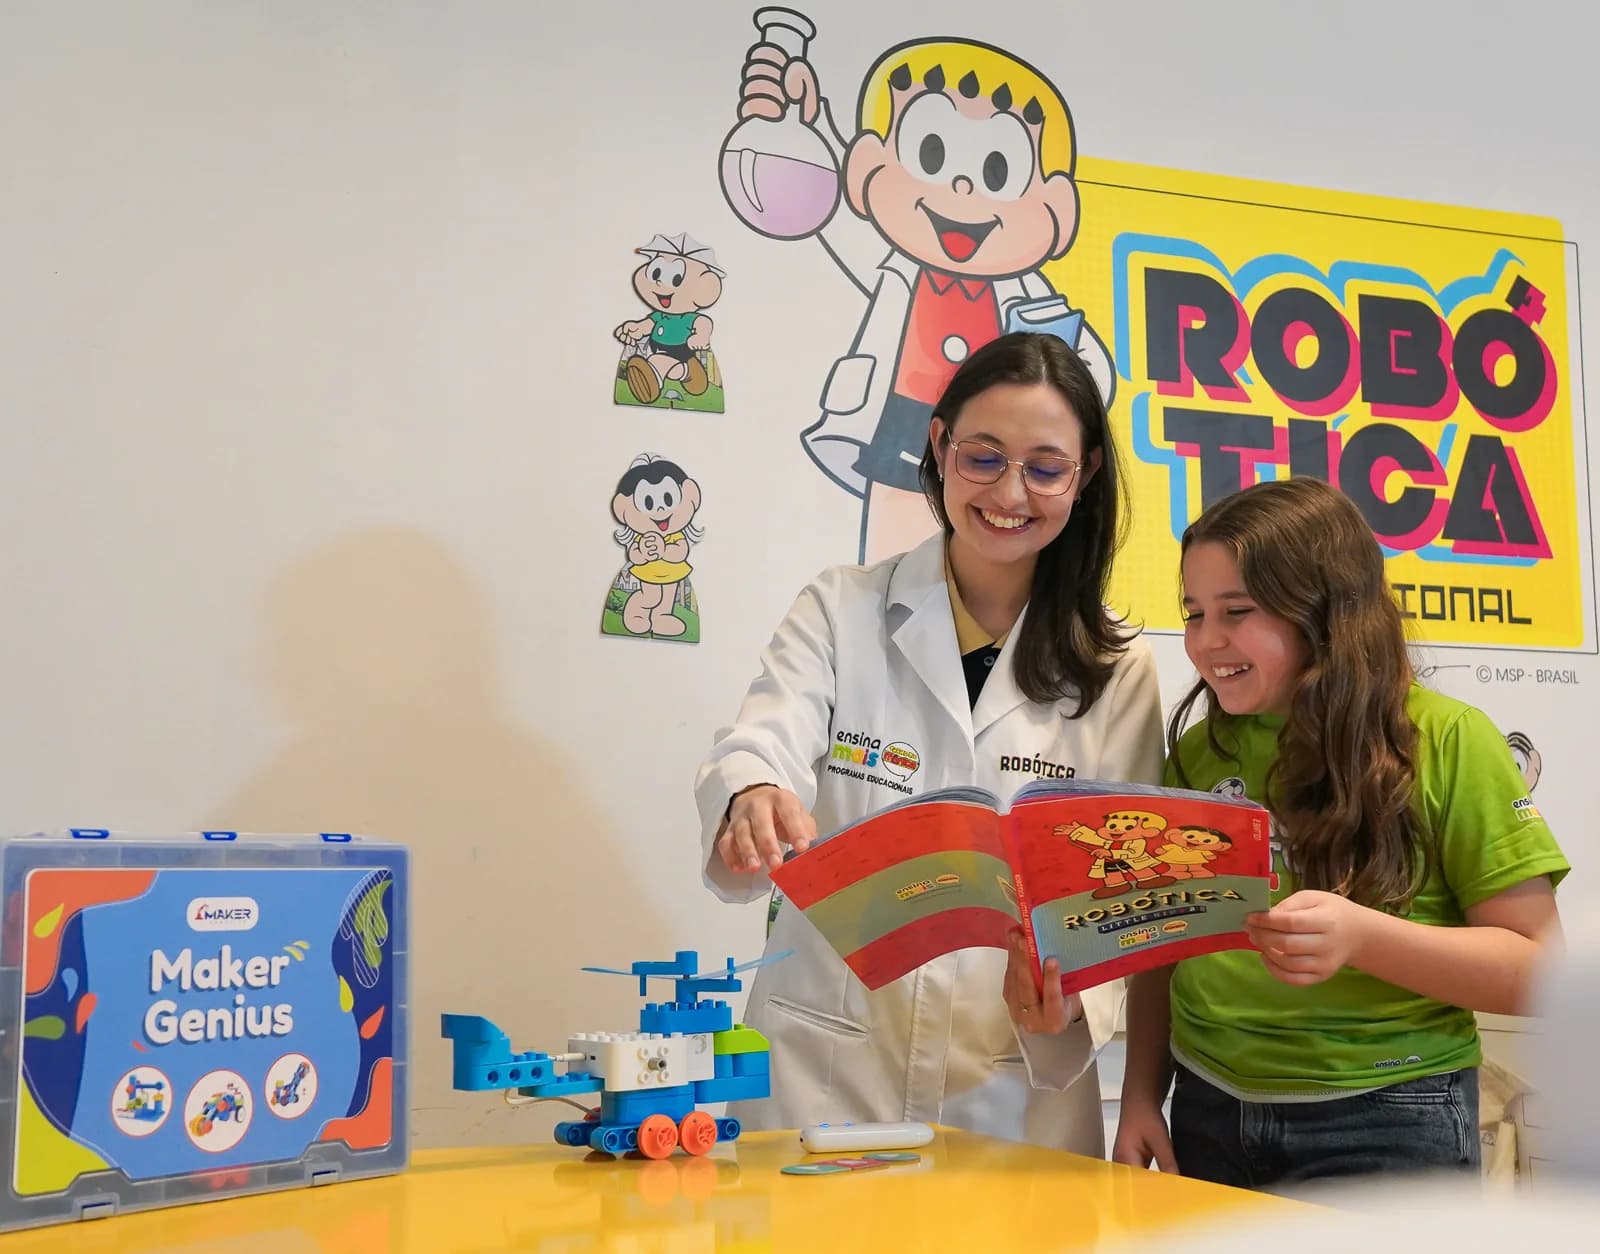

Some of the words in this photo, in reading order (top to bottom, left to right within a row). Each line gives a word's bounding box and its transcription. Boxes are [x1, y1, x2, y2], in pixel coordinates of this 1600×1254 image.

[1144, 267, 1557, 432] ROBÓ
[1163, 407, 1553, 558] TICA
[1391, 583, 1533, 625] IONAL
[1496, 668, 1525, 682] MSP
[1536, 669, 1580, 684] BRASIL
[836, 729, 881, 750] ensina
[832, 743, 879, 768] mais
[1000, 752, 1076, 779] ROBÓTICA
[827, 764, 865, 781] PROGRAMAS
[866, 774, 914, 795] EDUCACIONAIS
[1512, 797, 1532, 809] ens
[1064, 888, 1246, 930] ROBÓTICA
[1119, 925, 1157, 940] ensina
[150, 944, 291, 994] Maker
[143, 993, 295, 1046] Genius
